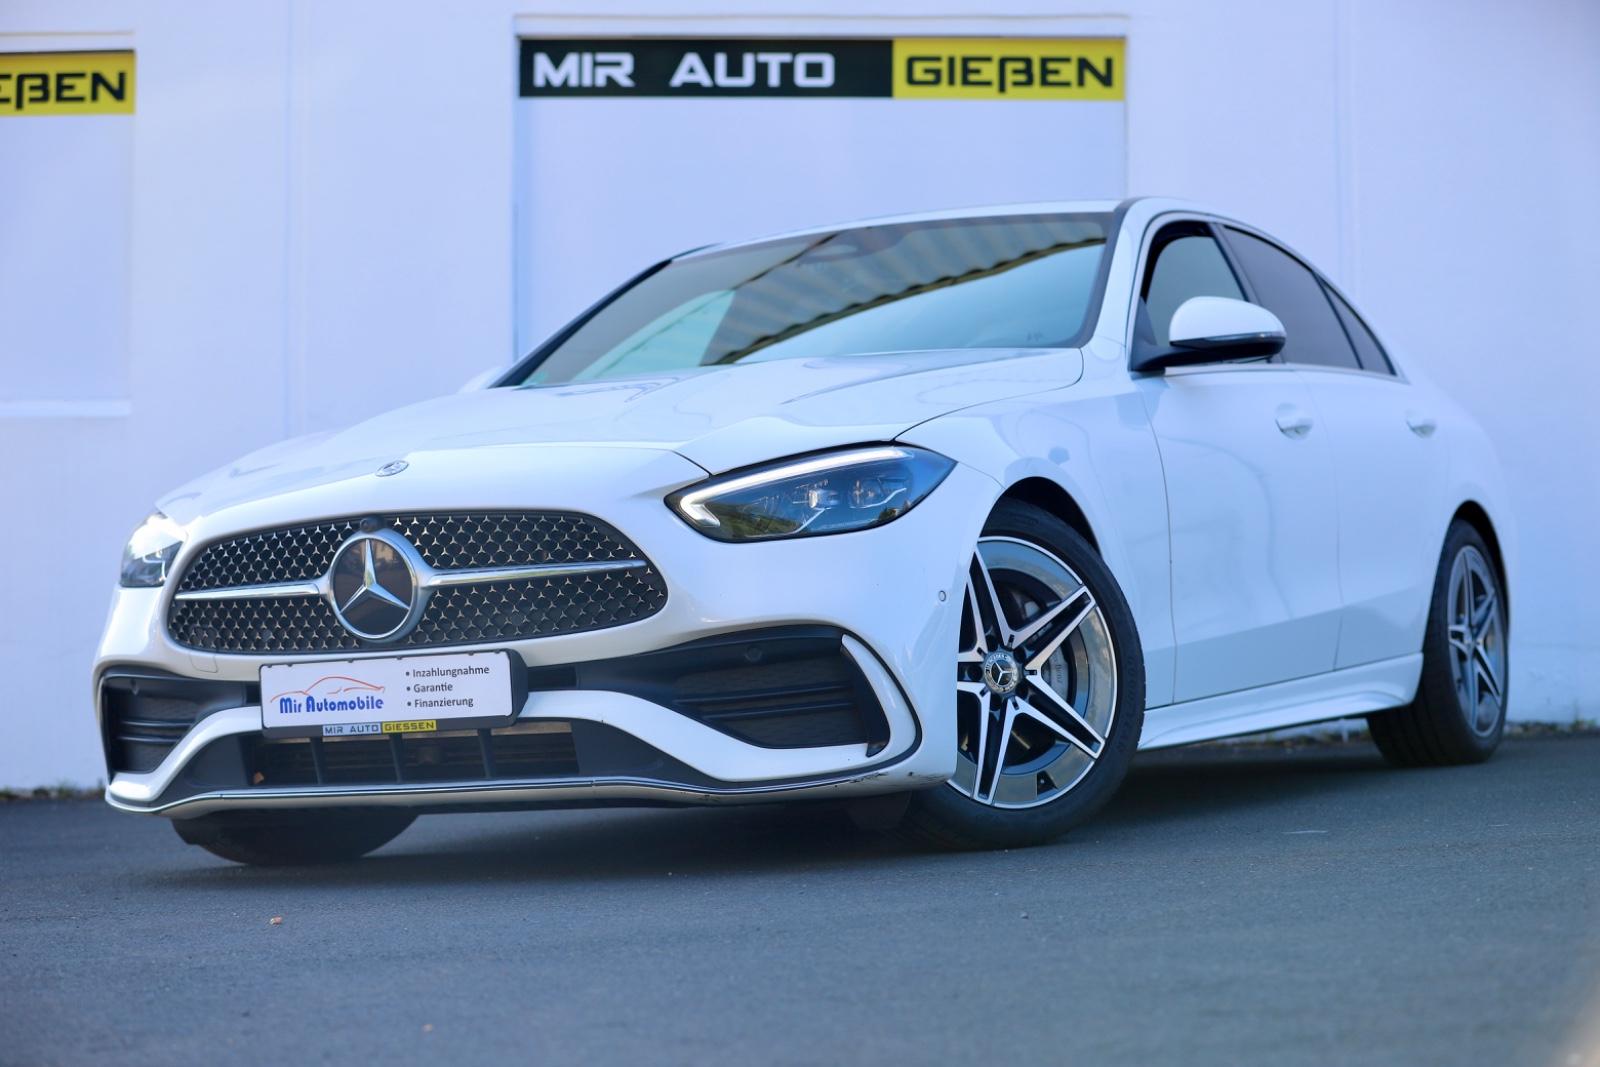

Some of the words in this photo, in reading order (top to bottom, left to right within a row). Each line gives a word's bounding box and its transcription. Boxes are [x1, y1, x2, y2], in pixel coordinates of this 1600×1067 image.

[533, 52, 634, 87] MIR
[670, 52, 835, 88] AUTO
[906, 56, 1113, 93] GIEßEN
[412, 666, 490, 678] Inzahlungnahme
[413, 682, 453, 693] Garantie
[280, 697, 302, 713] Mir
[306, 695, 384, 713] Automobile
[414, 697, 474, 708] Finanzierung
[325, 725, 344, 734] MIR
[350, 723, 379, 733] AUTO
[384, 721, 435, 732] GIESSEN
